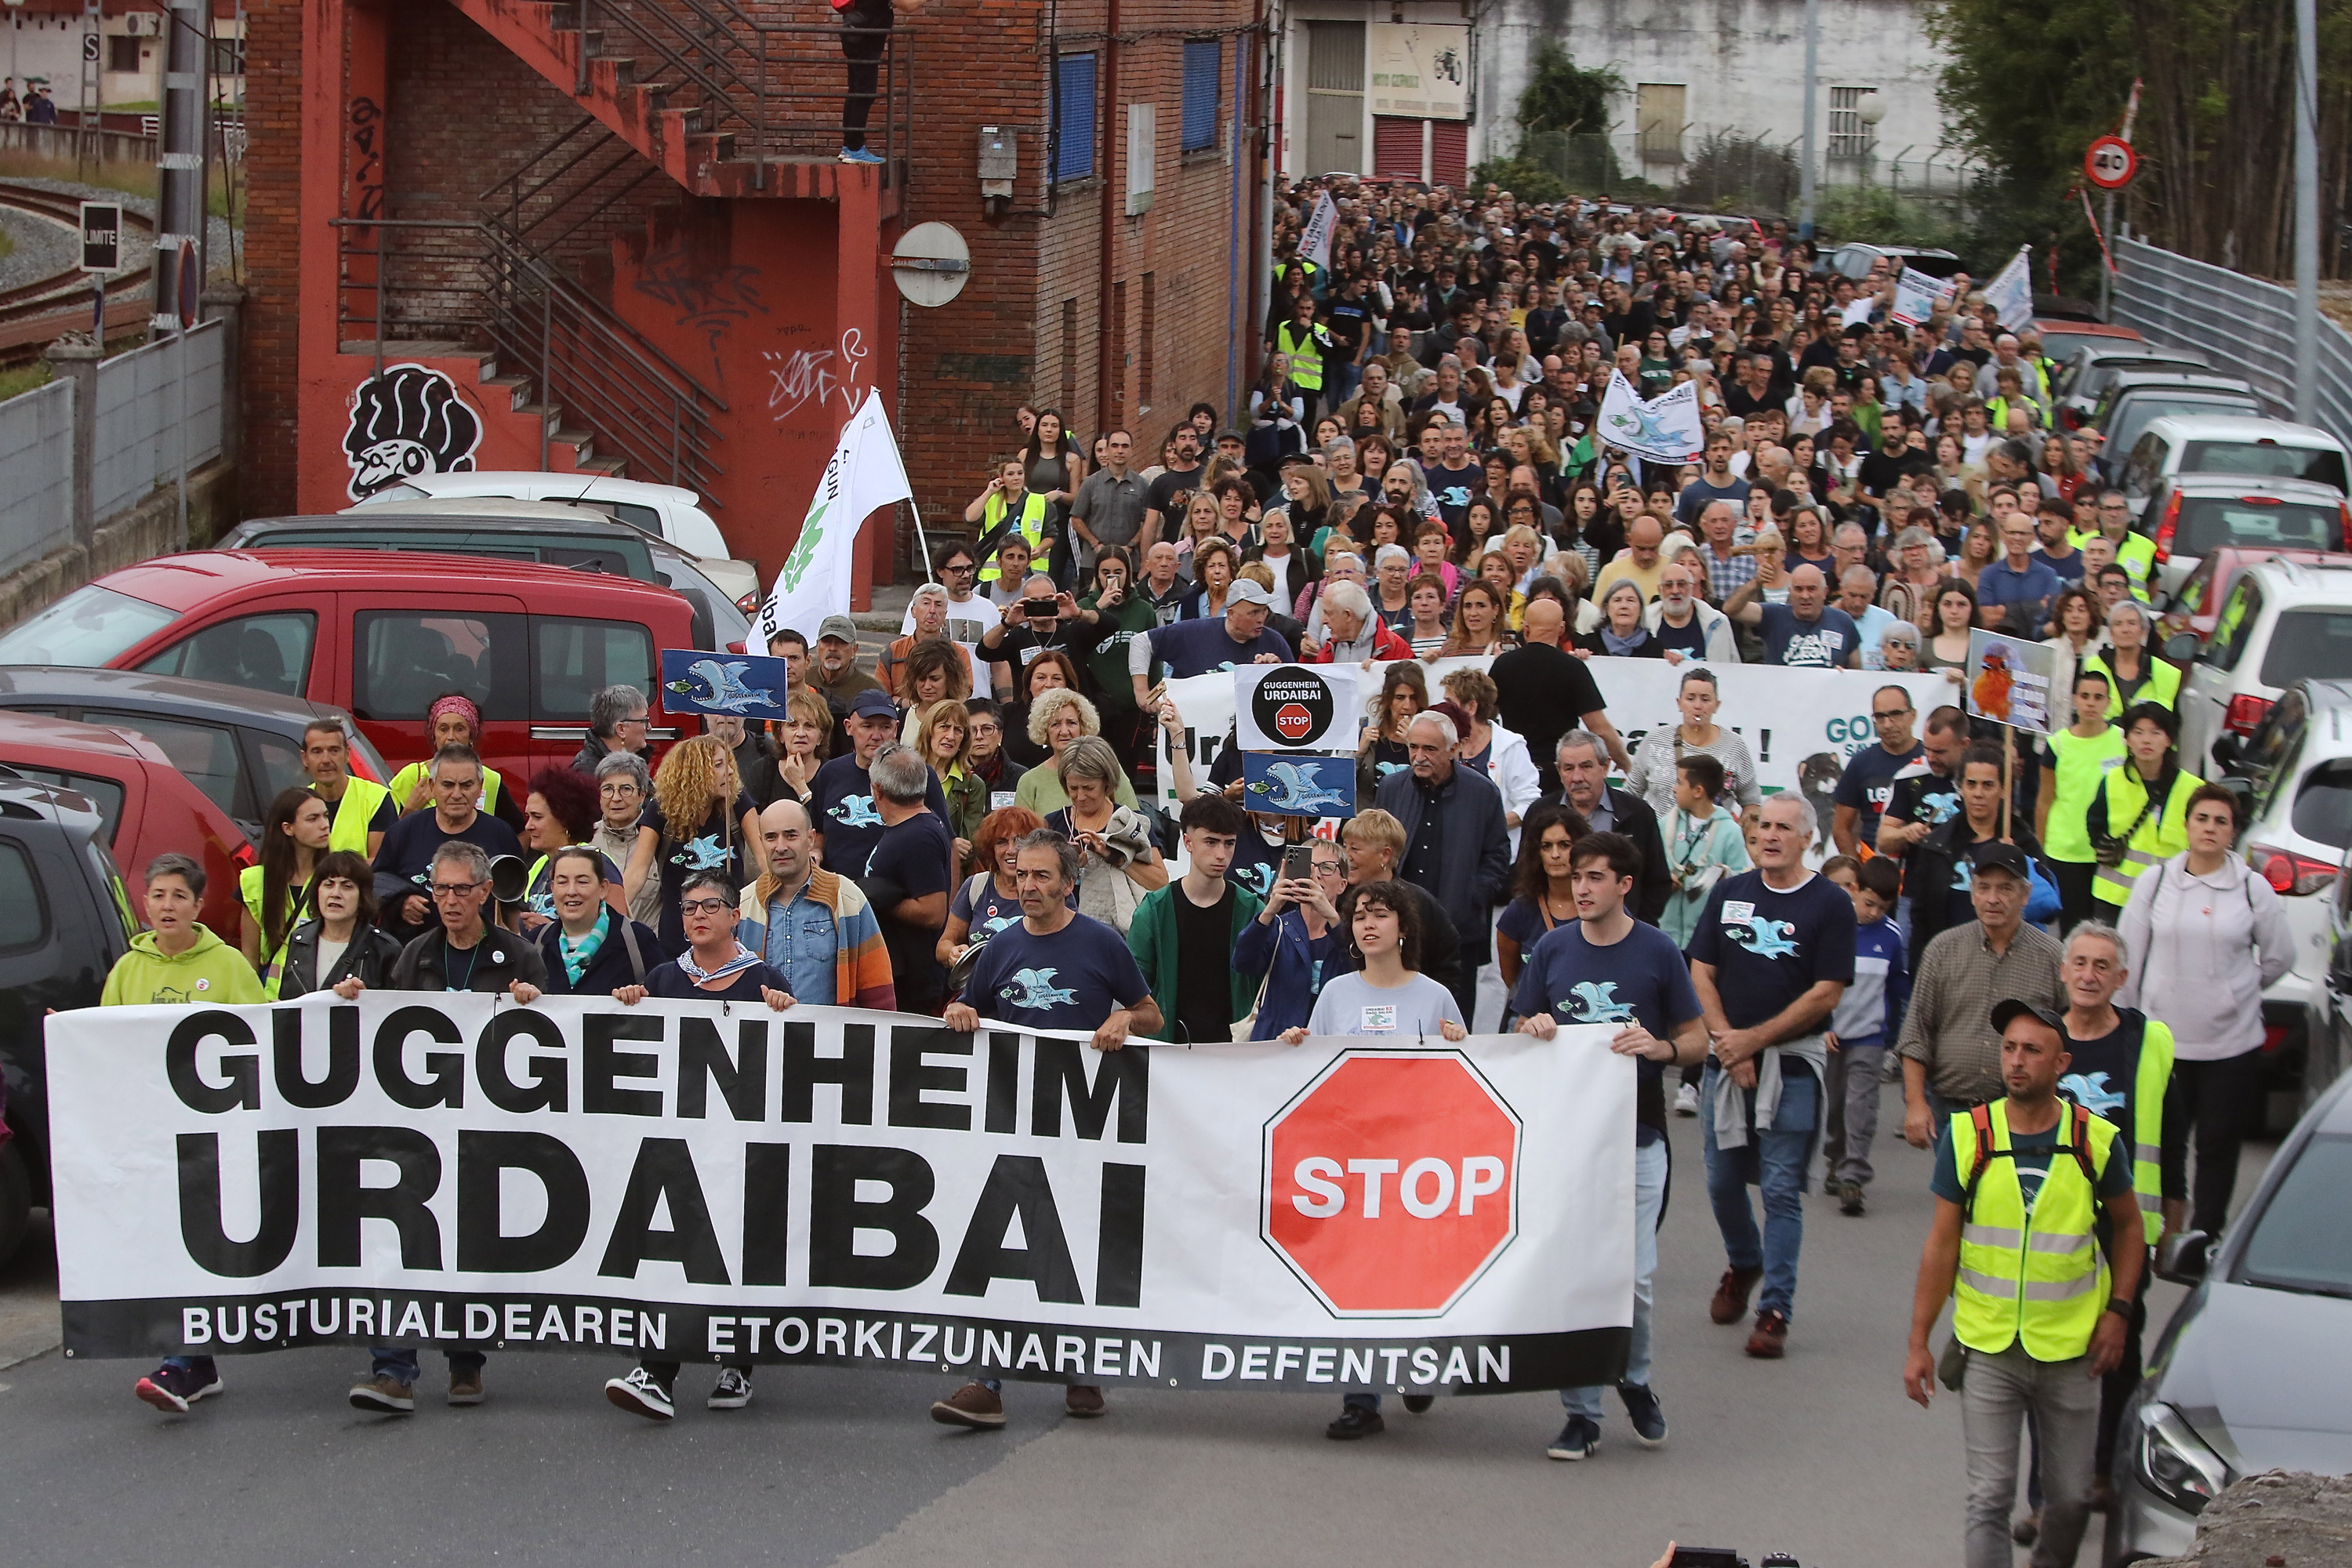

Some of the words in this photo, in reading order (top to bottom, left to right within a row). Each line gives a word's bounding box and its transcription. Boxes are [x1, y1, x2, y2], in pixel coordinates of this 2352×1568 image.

[84, 34, 99, 60] S
[2095, 154, 2123, 170] 40
[85, 230, 116, 245] LIMITE
[1264, 690, 1321, 701] URDAIBAI
[1279, 717, 1308, 726] STOP
[165, 1005, 1149, 1144] GUGGENHEIM
[1291, 1156, 1504, 1219] STOP
[176, 1126, 1146, 1308] URDAIBAI
[183, 1298, 666, 1350] BUSTURIALDEAREN
[707, 1316, 1162, 1378] ETORKIZUNAREN
[1201, 1343, 1510, 1385] DEFENTSAN
